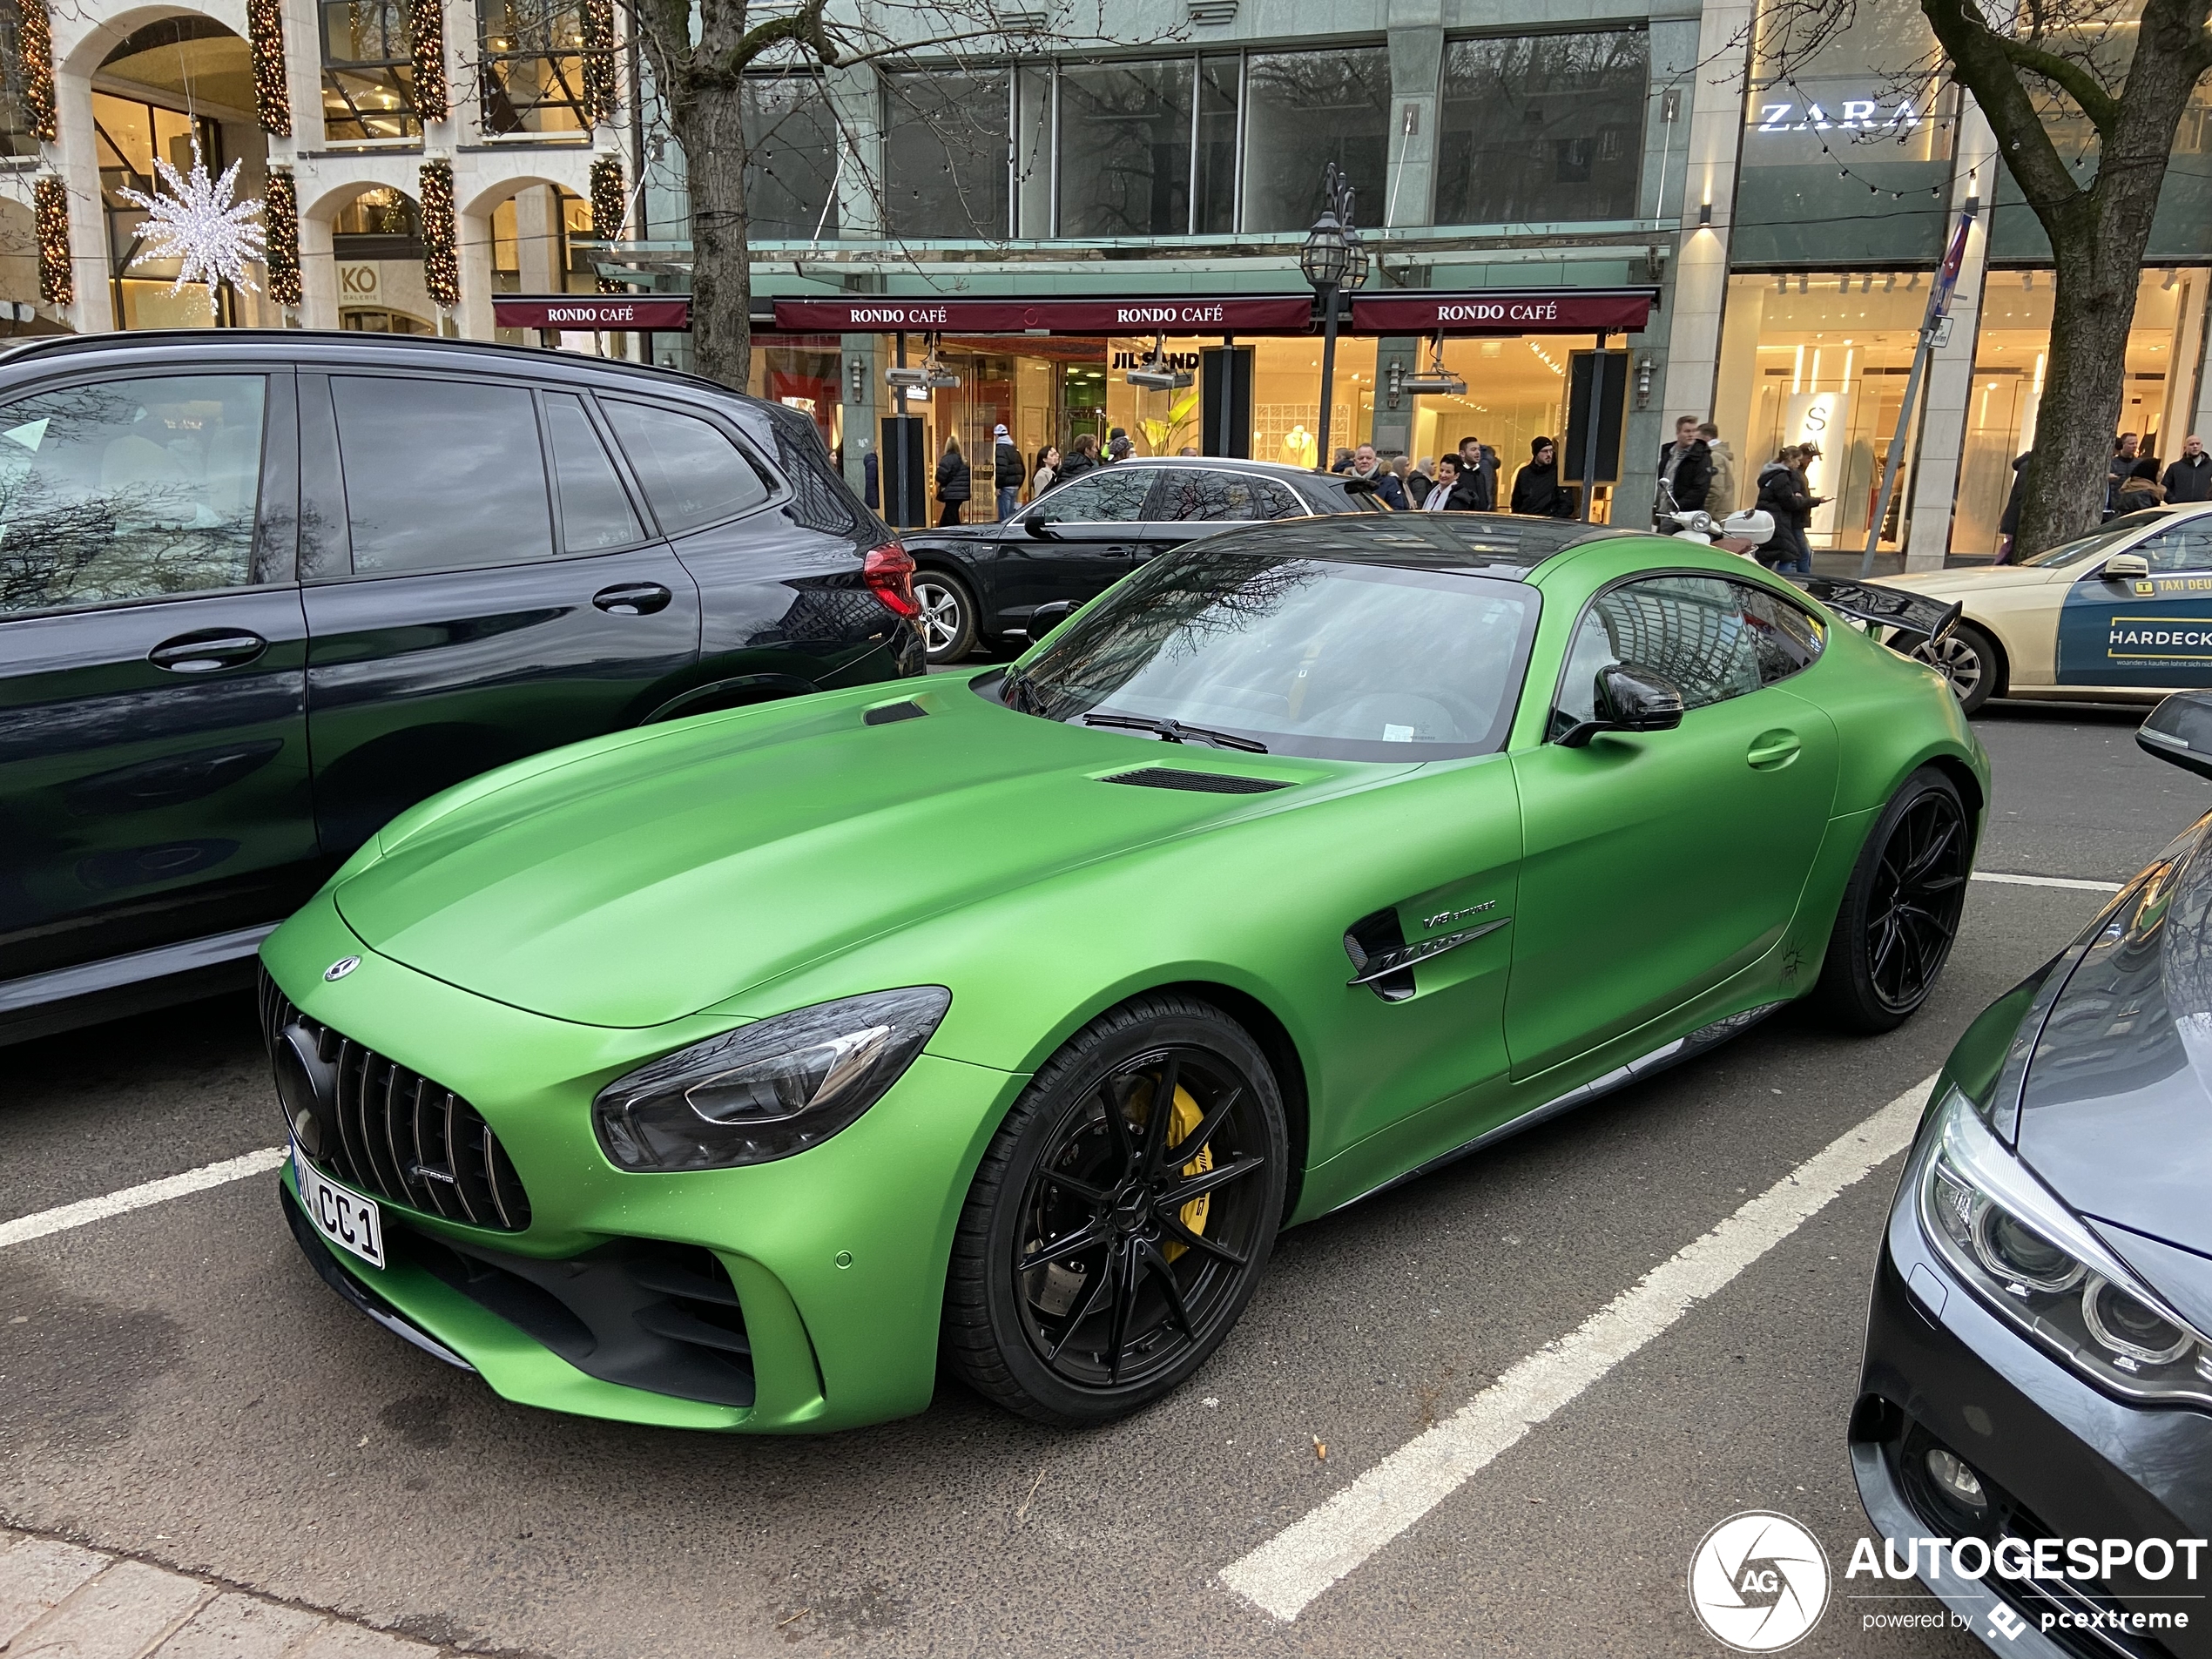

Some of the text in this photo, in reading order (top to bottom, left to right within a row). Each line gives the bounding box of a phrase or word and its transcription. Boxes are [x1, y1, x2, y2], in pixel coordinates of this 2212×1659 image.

[1757, 99, 1922, 132] ZARA
[548, 305, 634, 321] RONDO CAFÉ
[850, 306, 948, 323] RONDO CAFÉ
[1116, 303, 1223, 323] RONDO CAFÉ
[1437, 301, 1557, 320] RONDO CAFÉ
[1112, 352, 1138, 369] JIL
[2158, 580, 2184, 590] TAXI
[2188, 578, 2212, 590] DEU
[2109, 631, 2212, 645] HARDECK
[1422, 900, 1496, 930] V8 BITURBO
